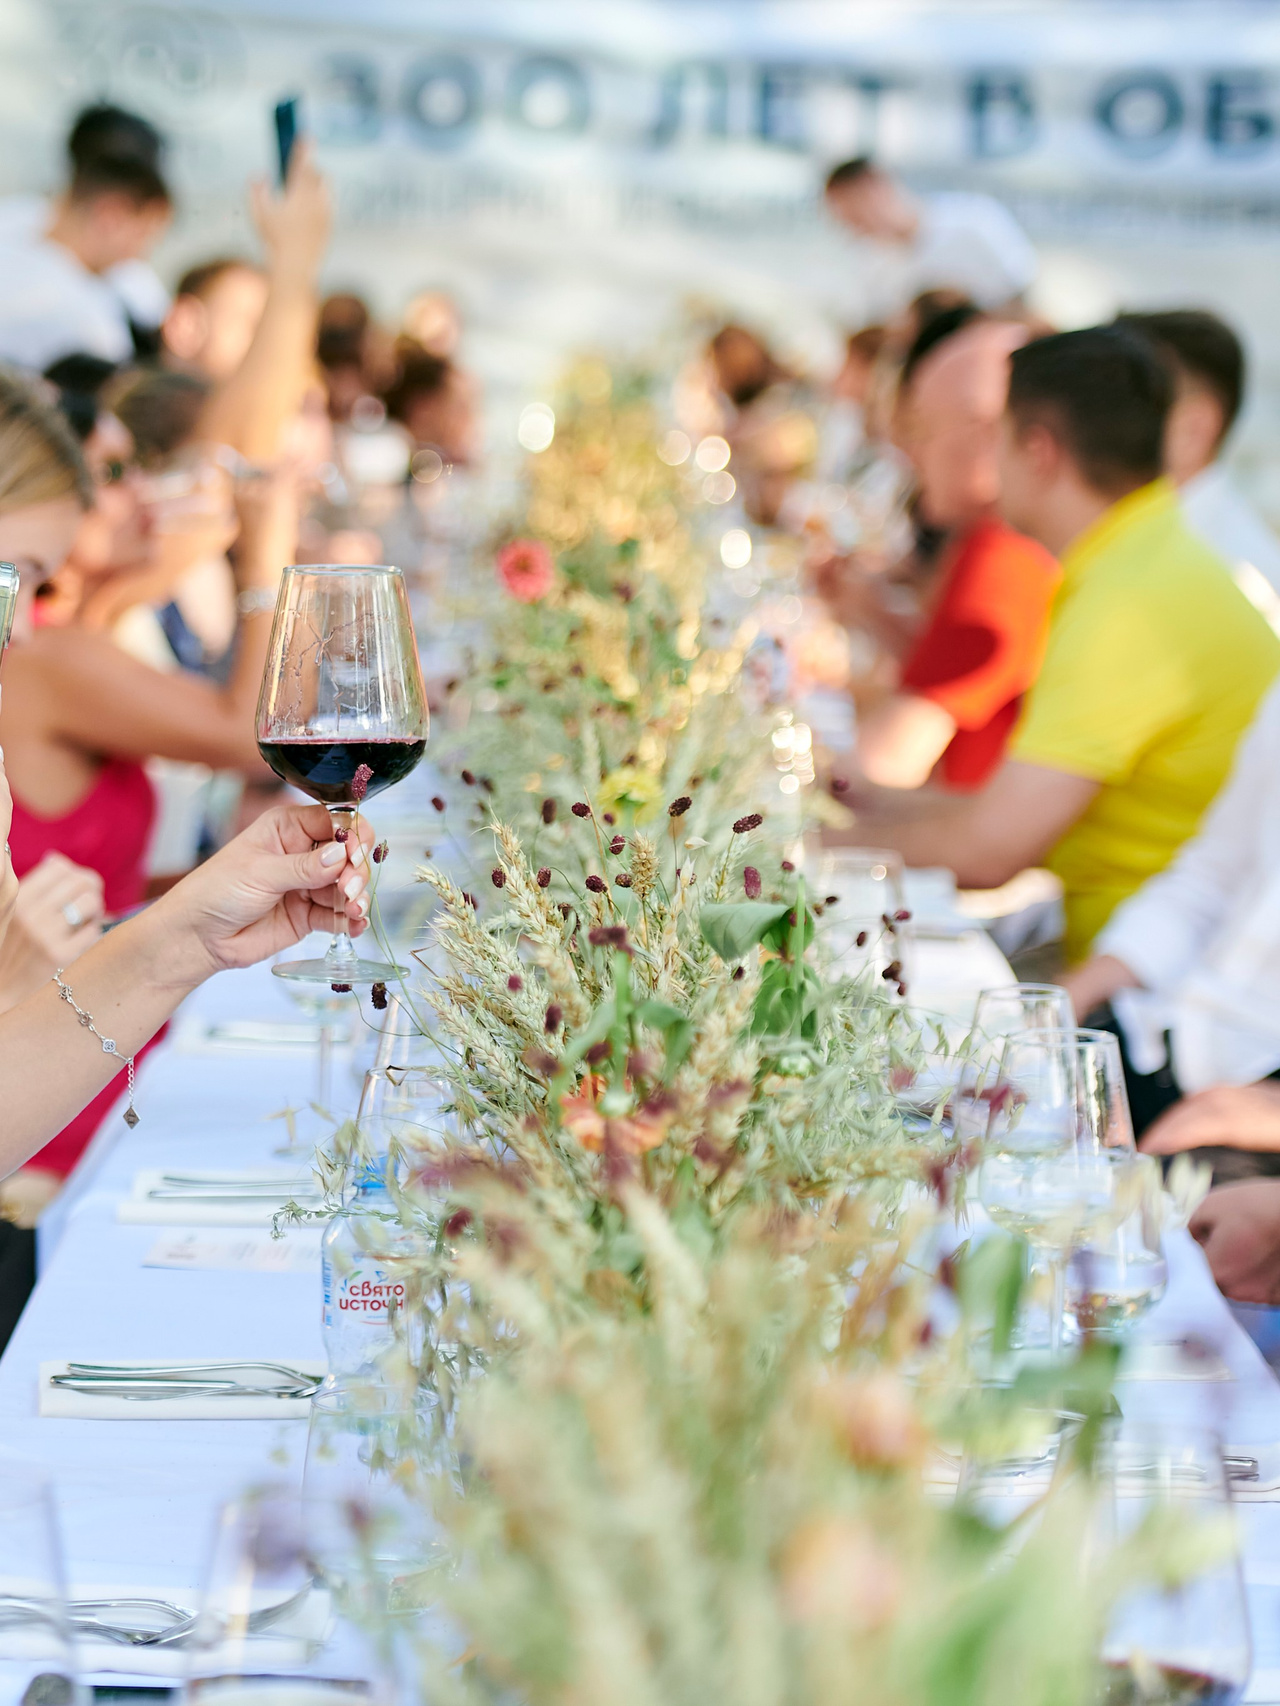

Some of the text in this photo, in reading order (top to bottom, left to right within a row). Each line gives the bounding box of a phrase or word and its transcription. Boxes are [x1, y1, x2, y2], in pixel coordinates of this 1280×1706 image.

[320, 51, 592, 151] 300
[652, 60, 896, 152] ЛЕТ
[966, 67, 1040, 159] В
[1097, 69, 1280, 160] ОБ
